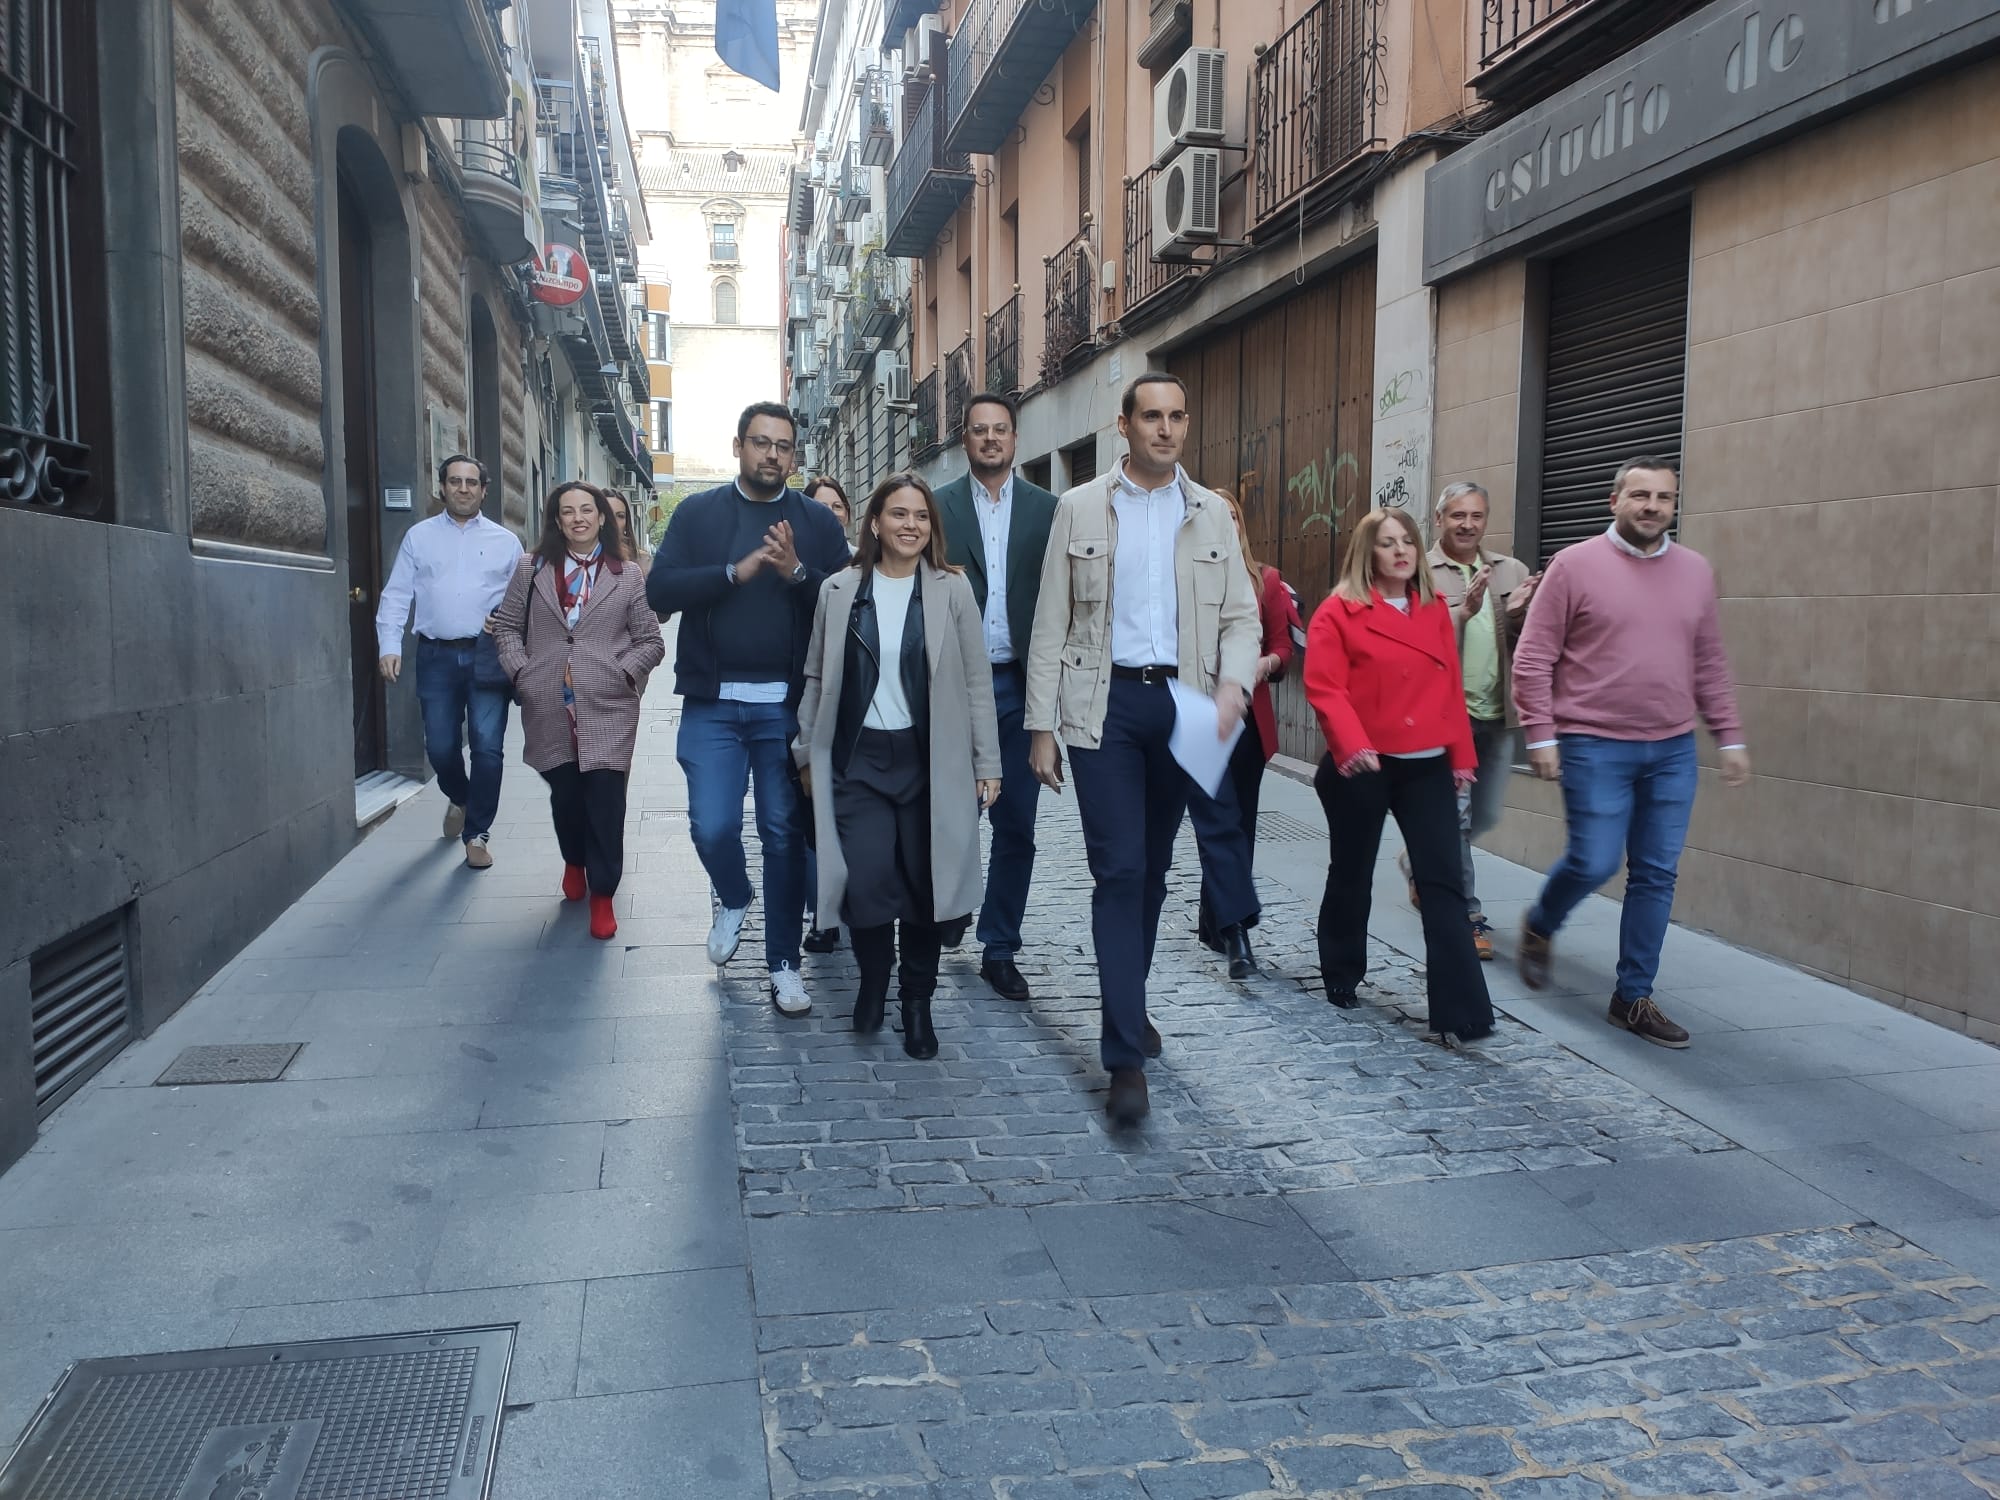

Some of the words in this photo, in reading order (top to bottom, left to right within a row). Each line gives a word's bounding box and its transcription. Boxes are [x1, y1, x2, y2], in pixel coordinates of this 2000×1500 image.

[1486, 81, 1670, 211] estudio
[1725, 11, 1804, 93] de
[537, 273, 579, 290] uzcampo
